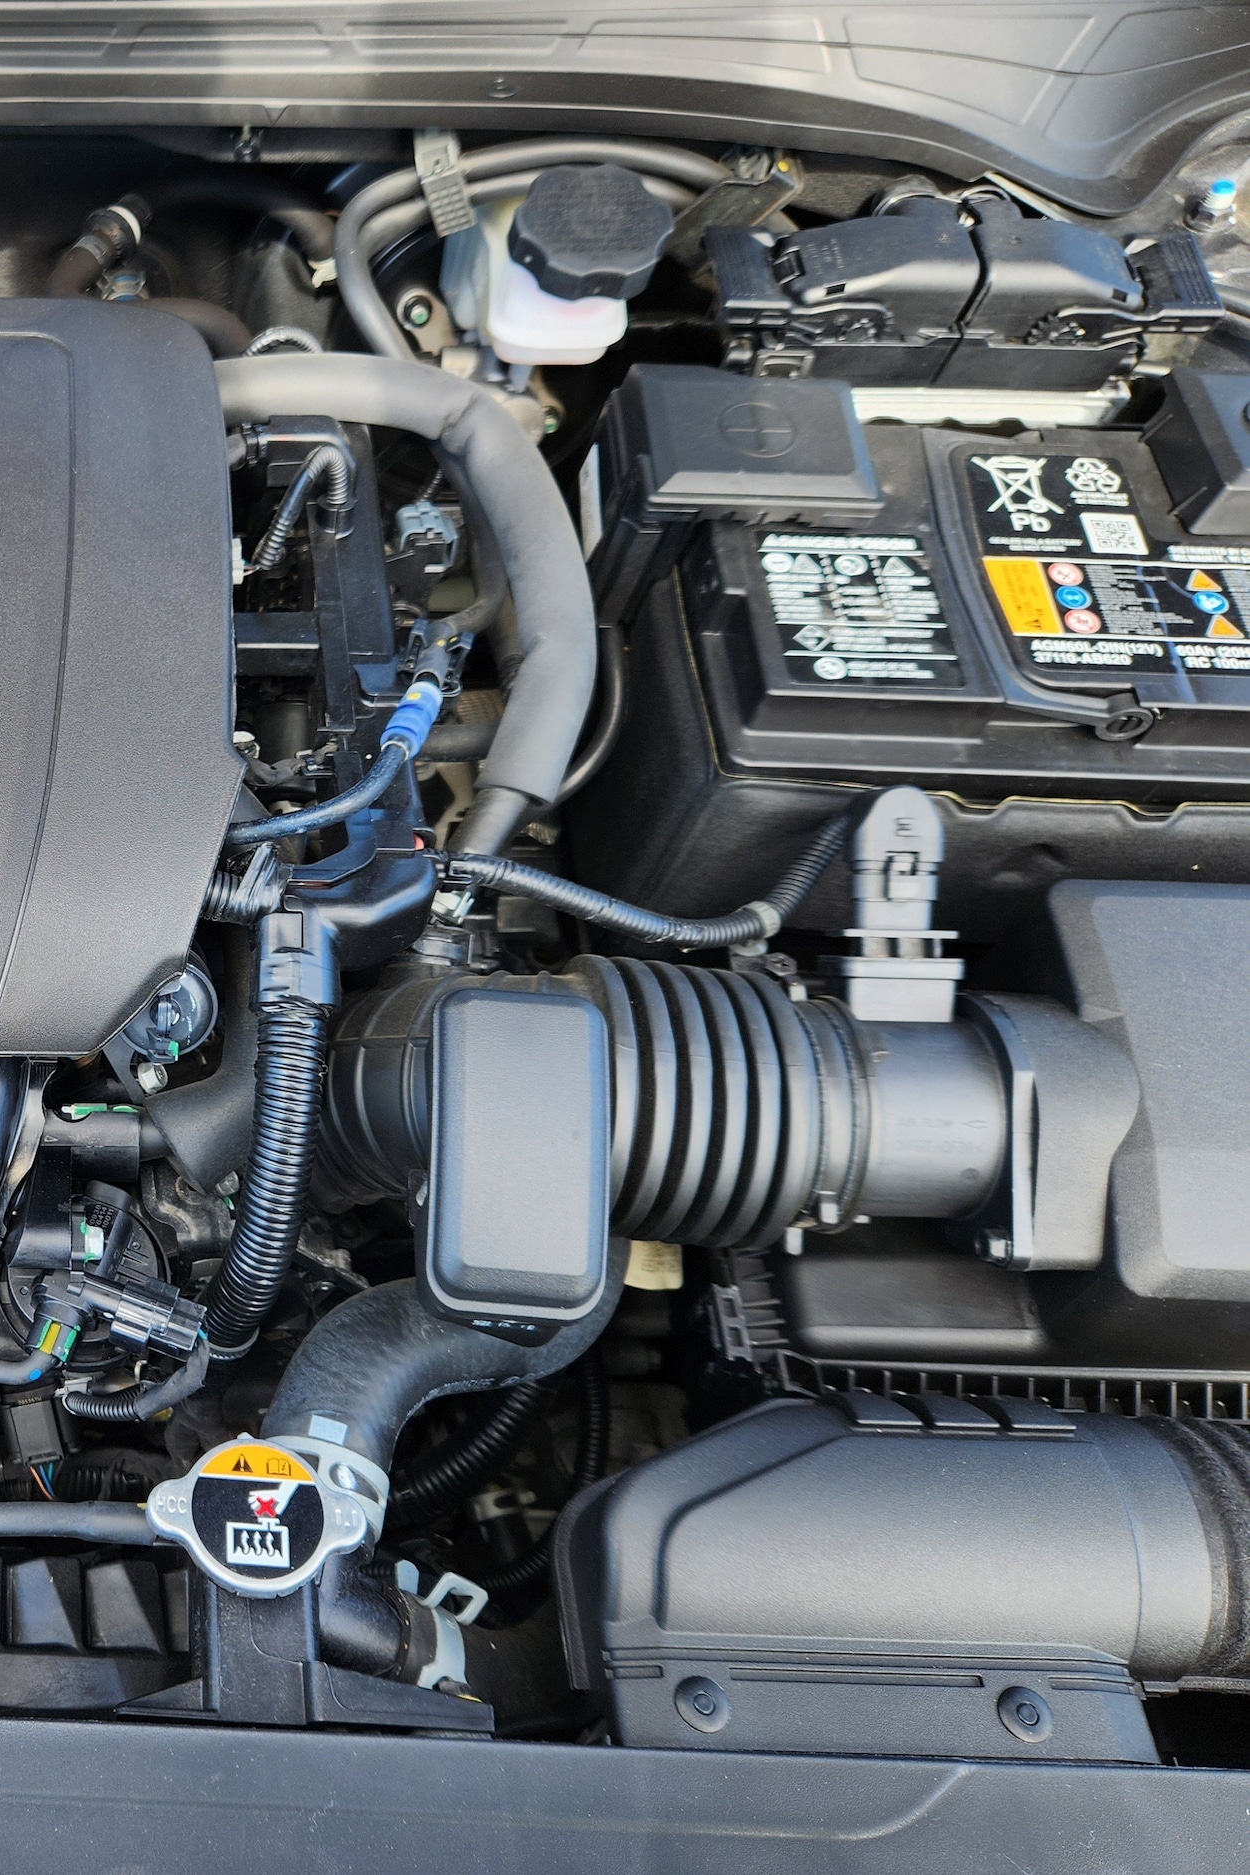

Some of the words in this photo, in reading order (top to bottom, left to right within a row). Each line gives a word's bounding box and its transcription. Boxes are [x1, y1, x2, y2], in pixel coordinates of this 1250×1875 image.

[1010, 512, 1051, 532] Pb
[1033, 651, 1133, 666] 37110-AB620
[1175, 645, 1216, 657] 60Ah
[1184, 656, 1212, 668] RC
[156, 1496, 187, 1515] HCC
